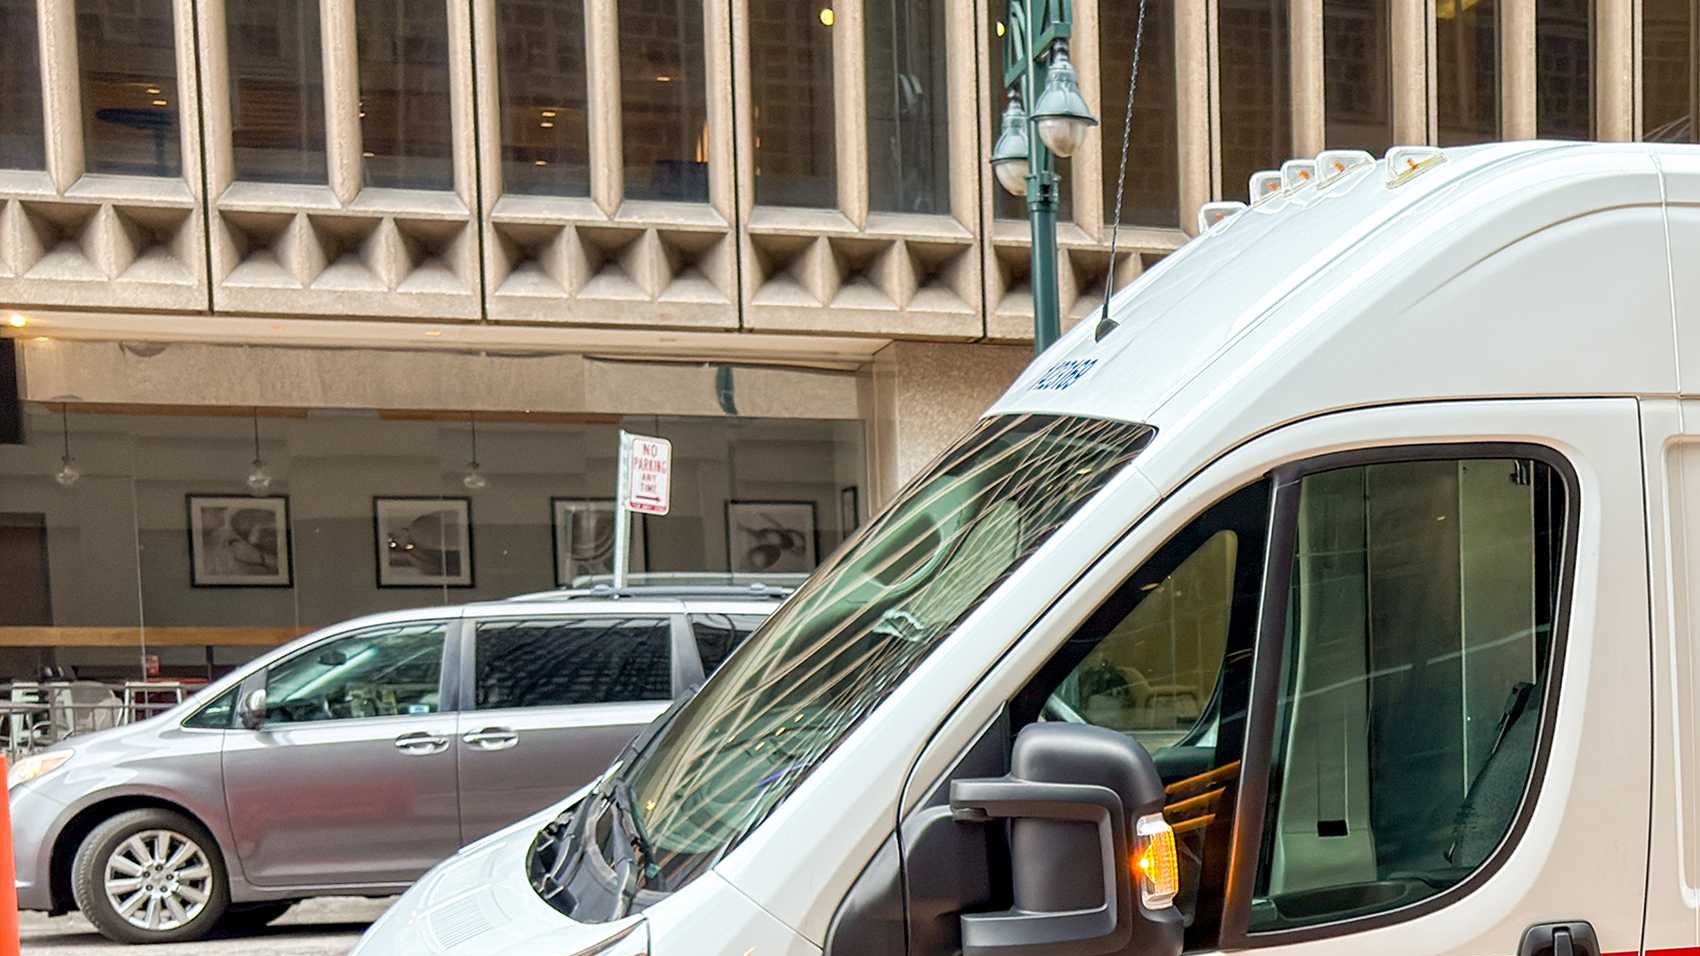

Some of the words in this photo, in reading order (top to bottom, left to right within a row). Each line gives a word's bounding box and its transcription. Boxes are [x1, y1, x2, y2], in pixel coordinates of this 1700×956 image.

[643, 444, 658, 457] NO
[633, 458, 667, 474] PARKING
[641, 474, 657, 483] ANY
[641, 483, 656, 493] TIME
